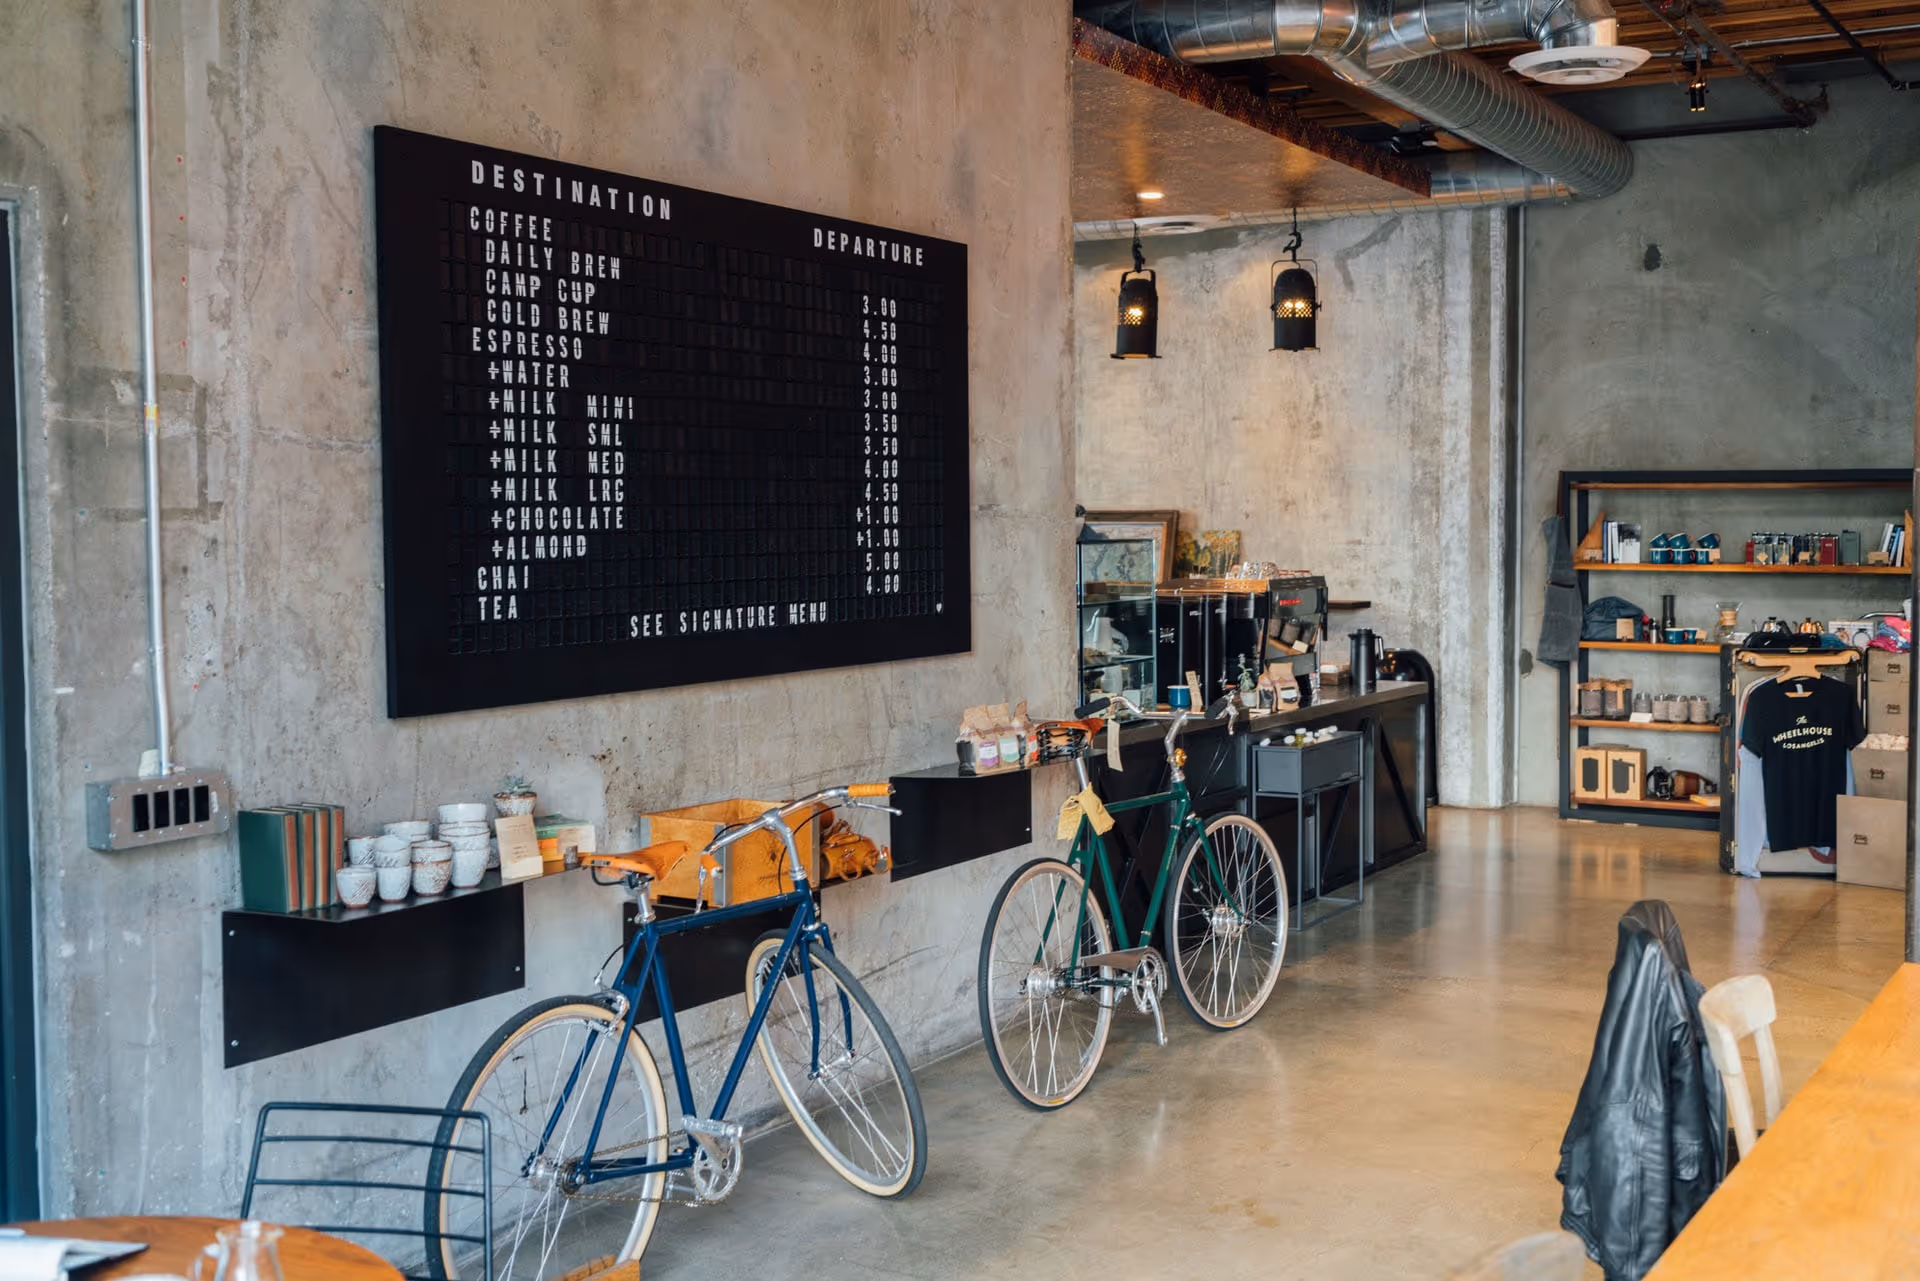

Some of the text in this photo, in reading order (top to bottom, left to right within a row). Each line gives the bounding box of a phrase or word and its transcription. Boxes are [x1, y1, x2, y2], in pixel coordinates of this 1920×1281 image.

[471, 160, 672, 221] DESTINATION
[470, 206, 552, 242] COFFEE
[485, 239, 620, 280] DAILY BREW
[813, 228, 924, 266] DEPARTURE
[486, 268, 596, 304] CAMP CUP
[487, 299, 610, 335] COLD BREW
[863, 295, 897, 318] 3.00
[863, 319, 897, 341] 4.50
[472, 327, 582, 360] ESPRESSO
[863, 342, 897, 364] 4.00
[487, 359, 569, 388] +WATER
[863, 365, 898, 387] 3.00
[488, 389, 633, 420] +MILK MINI
[863, 388, 898, 410] 3.00
[489, 418, 622, 447] +MILK SML
[864, 412, 898, 433] 3.50
[864, 435, 898, 456] 3.50
[489, 448, 624, 475] +MILK MED
[864, 458, 898, 479] 4.00
[490, 477, 624, 503] +MILK LRG
[865, 482, 899, 502] 4.50
[491, 506, 624, 531] +CHOCOLATE
[856, 505, 899, 525] +1.00
[491, 535, 587, 561] +ALMOND
[856, 528, 899, 548] +1.00
[866, 551, 899, 572] 5.00
[477, 565, 529, 591] CHAI
[866, 574, 900, 595] 4.00
[478, 594, 518, 621] TEA
[630, 601, 827, 638] SEE SIGNATURE MENU
[1772, 727, 1833, 743] WHEELHOUSE
